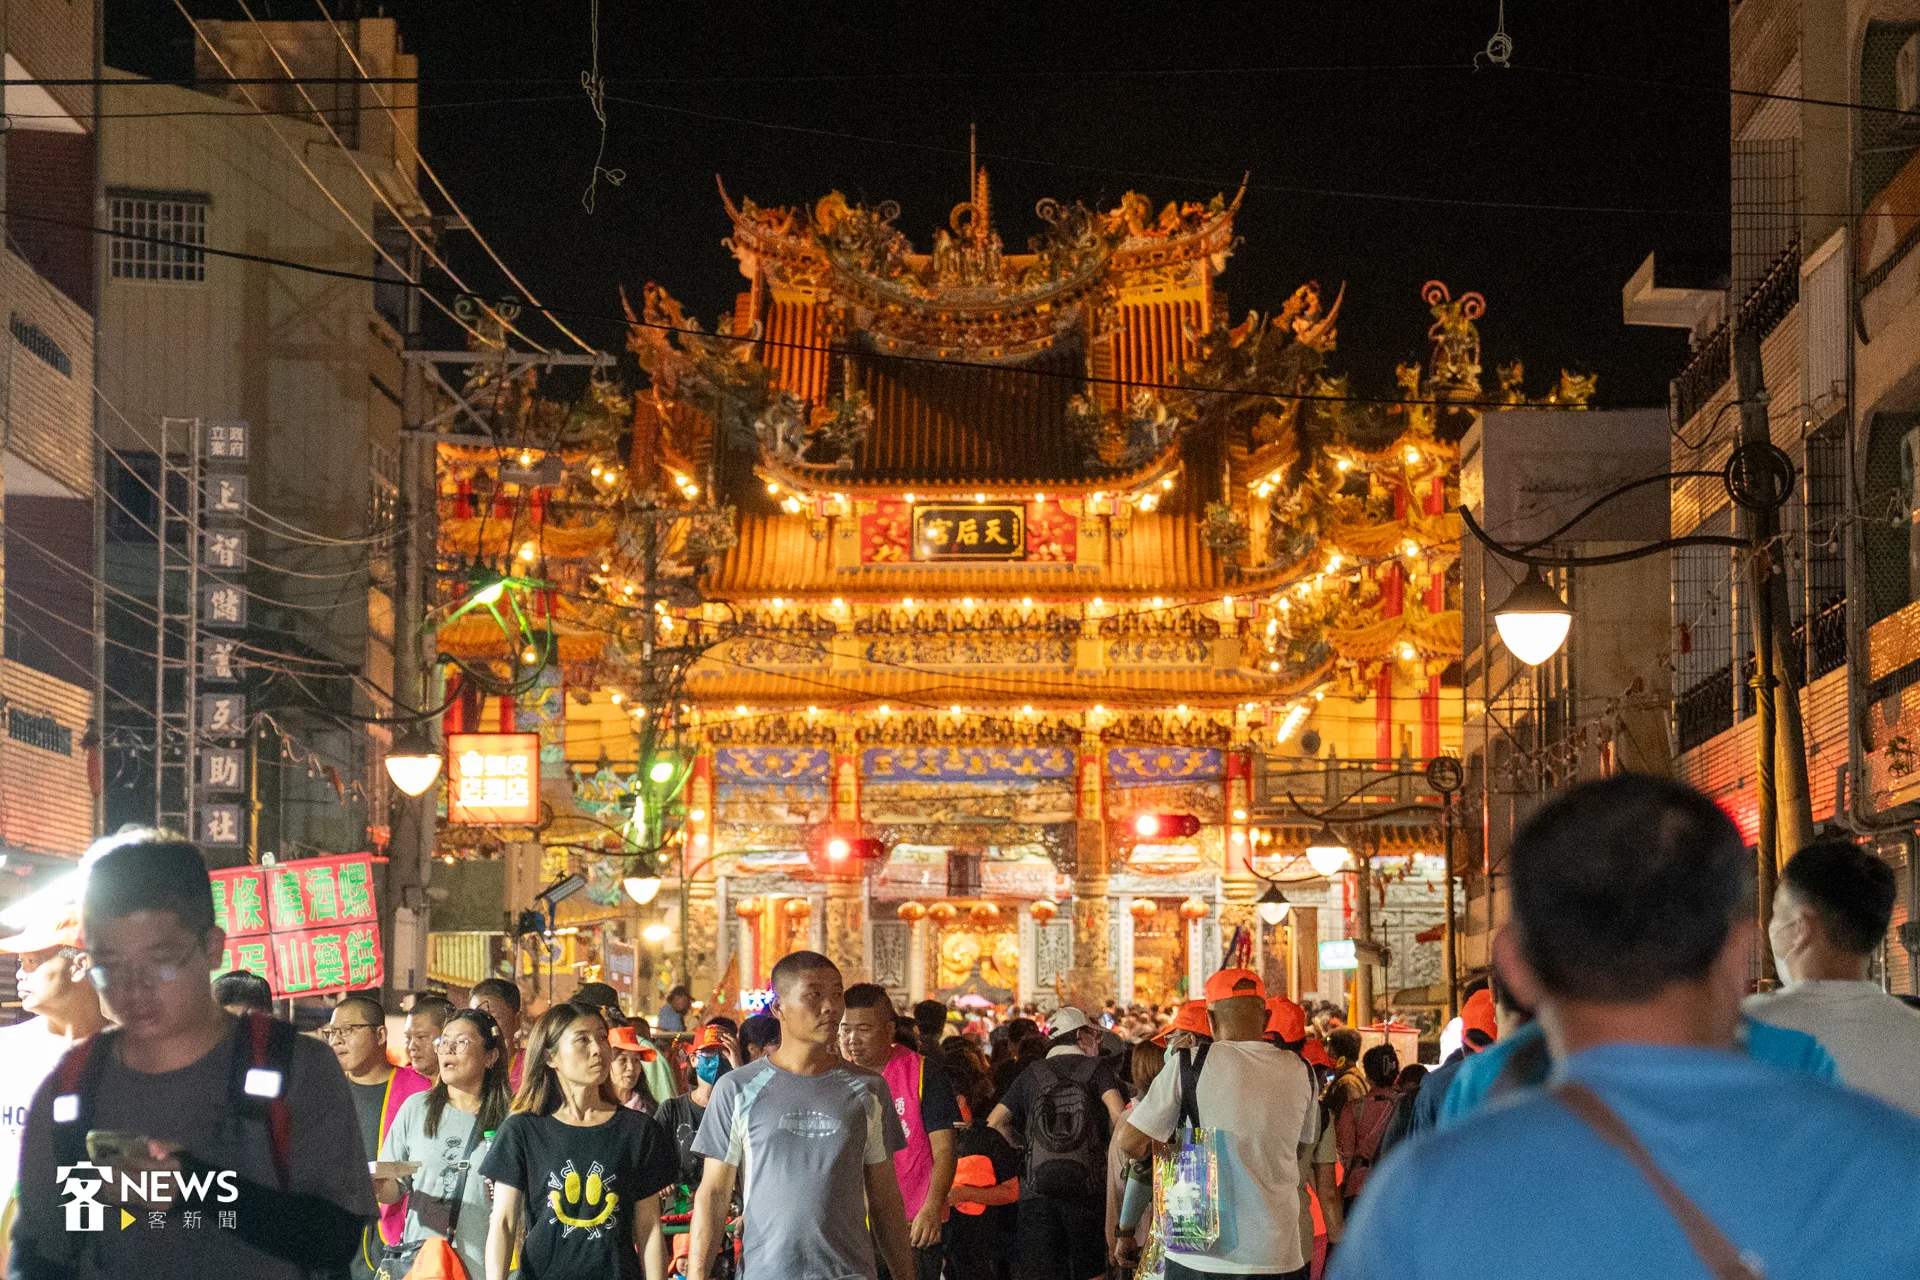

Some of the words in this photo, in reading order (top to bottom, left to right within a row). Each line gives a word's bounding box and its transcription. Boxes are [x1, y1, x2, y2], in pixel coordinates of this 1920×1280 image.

[273, 862, 372, 926] 燒酒螺
[279, 928, 377, 993] 山藥餅
